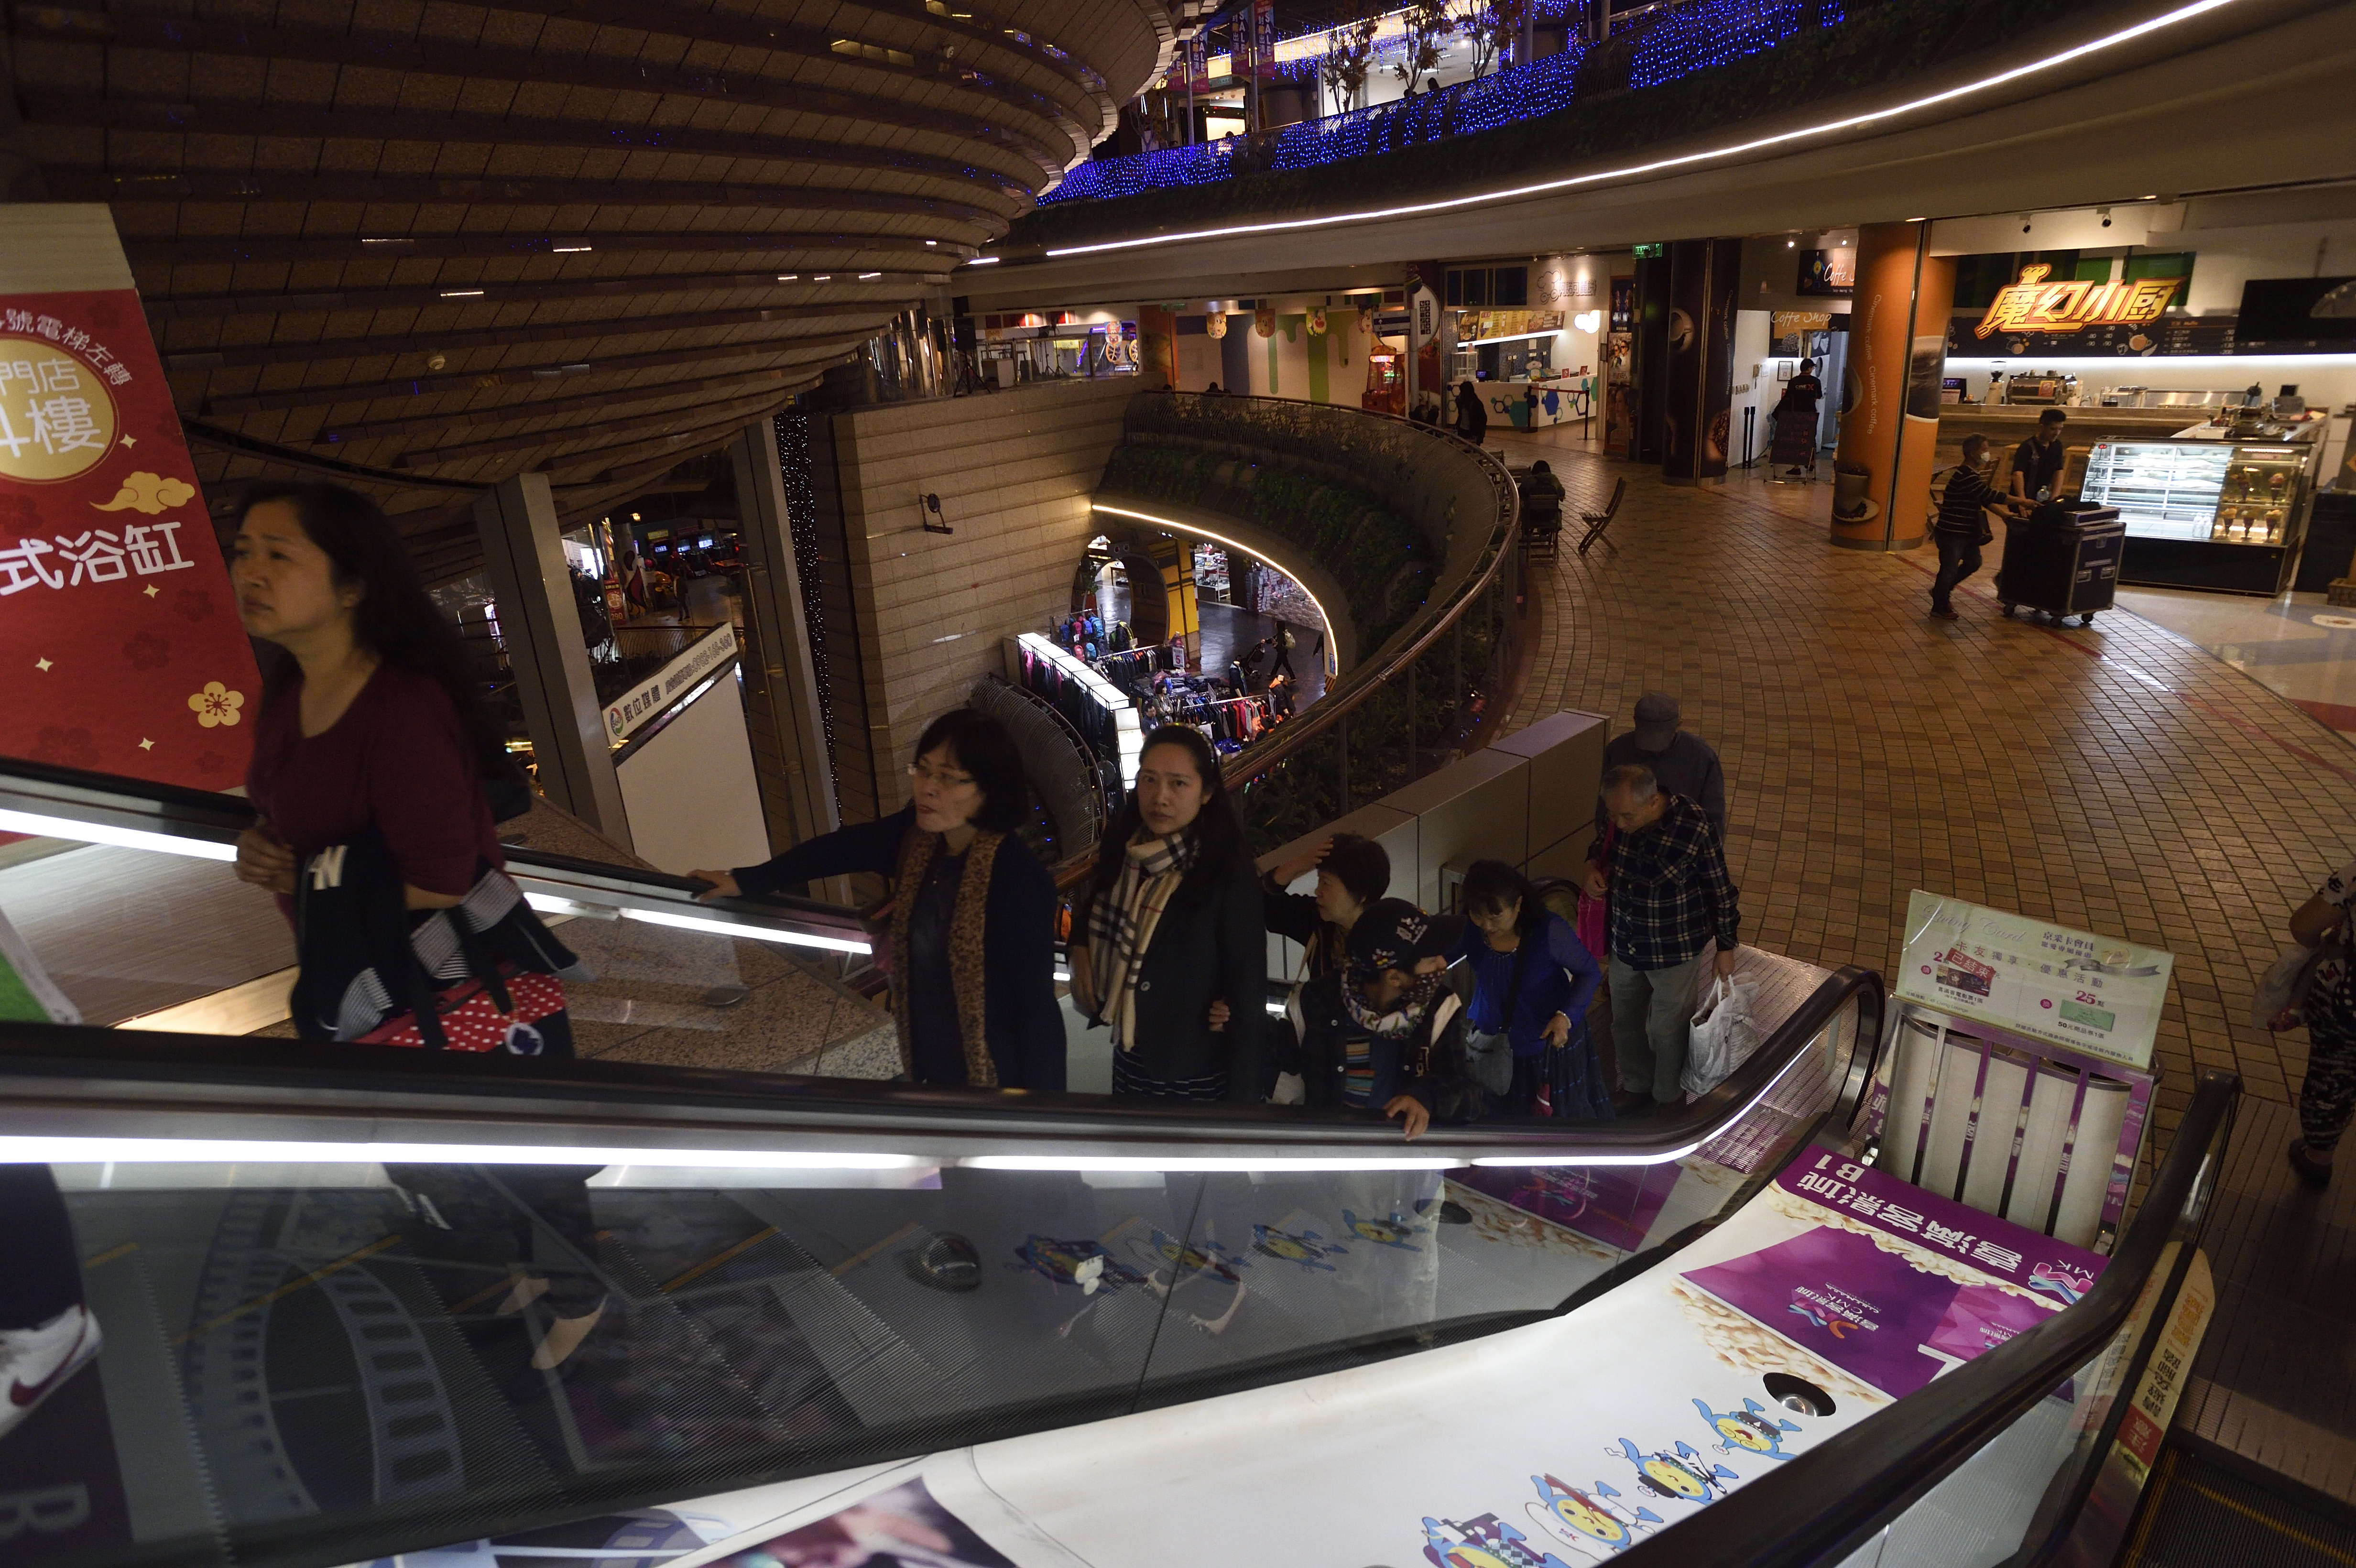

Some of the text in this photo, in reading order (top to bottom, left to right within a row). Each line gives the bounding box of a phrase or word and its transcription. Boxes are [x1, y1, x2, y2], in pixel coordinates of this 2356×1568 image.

[1865, 294, 1882, 333] Cinemark
[0, 308, 133, 387] 號電梯左轉
[1867, 366, 1878, 435] Cinemark coffee
[0, 522, 195, 596] 式浴缸
[1952, 951, 1990, 979] 已結束
[1814, 1154, 1865, 1182] B1
[1796, 1171, 2022, 1273] 喜滿客影城
[1824, 1293, 1863, 1314] CMK
